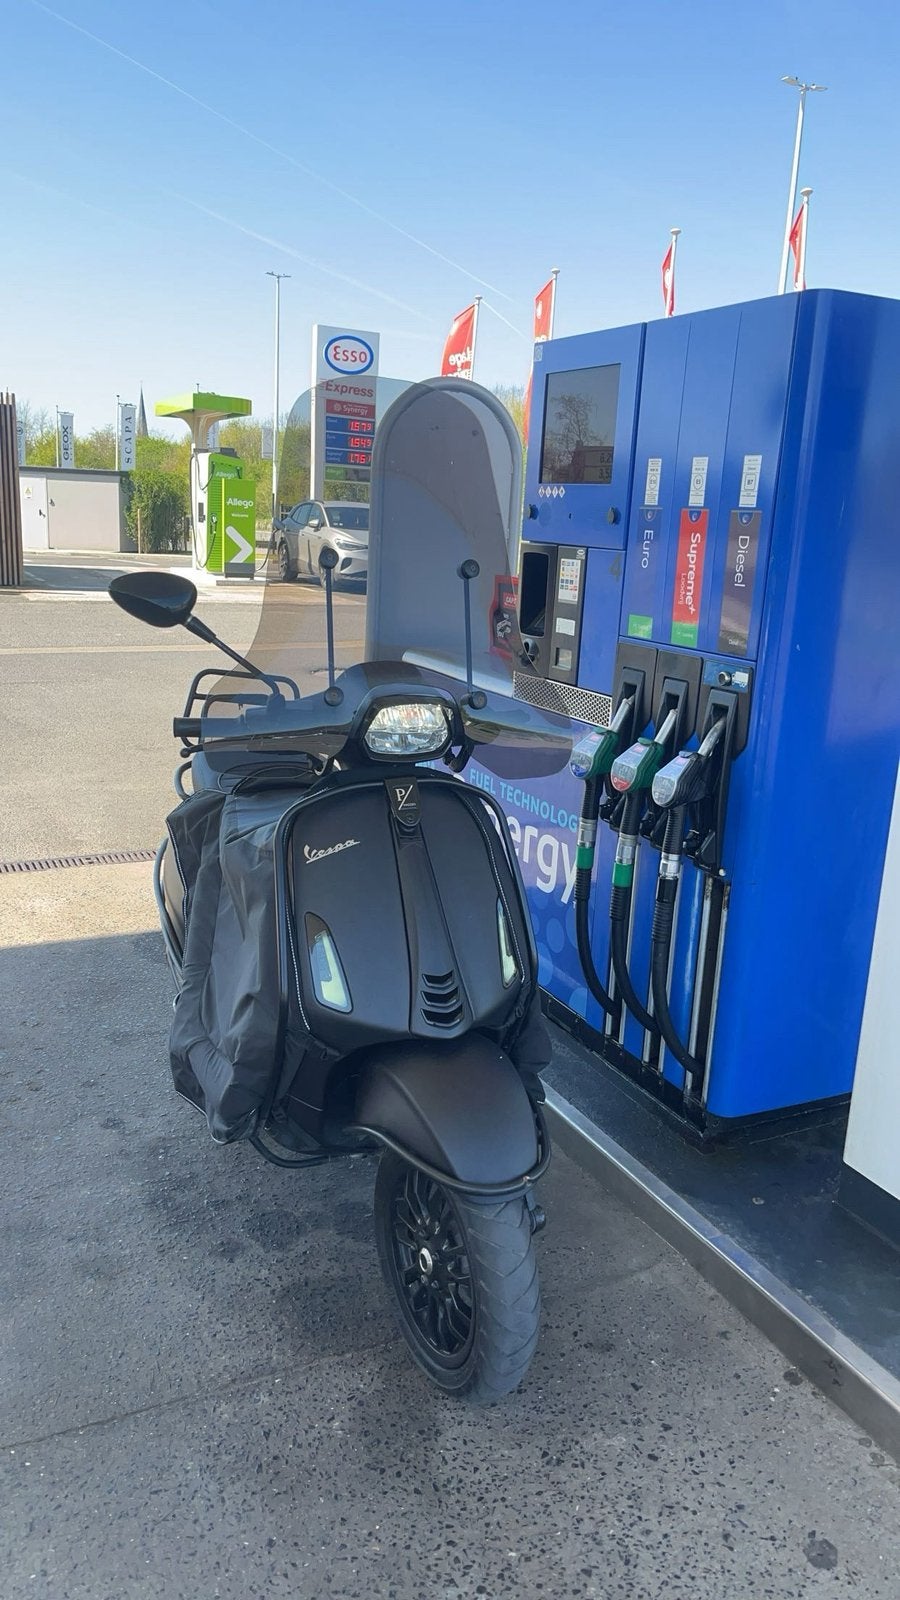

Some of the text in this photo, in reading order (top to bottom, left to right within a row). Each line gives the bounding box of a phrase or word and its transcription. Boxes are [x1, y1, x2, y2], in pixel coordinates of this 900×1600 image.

[325, 380, 374, 398] Express
[343, 404, 369, 416] Synergy
[62, 425, 70, 460] GEOX
[124, 416, 132, 464] SCAPA
[226, 497, 254, 509] Allego
[641, 529, 654, 569] Euro
[734, 535, 750, 588] Diesel
[469, 768, 578, 833] FUEL TECHNOLOG
[303, 839, 361, 864] Vespa
